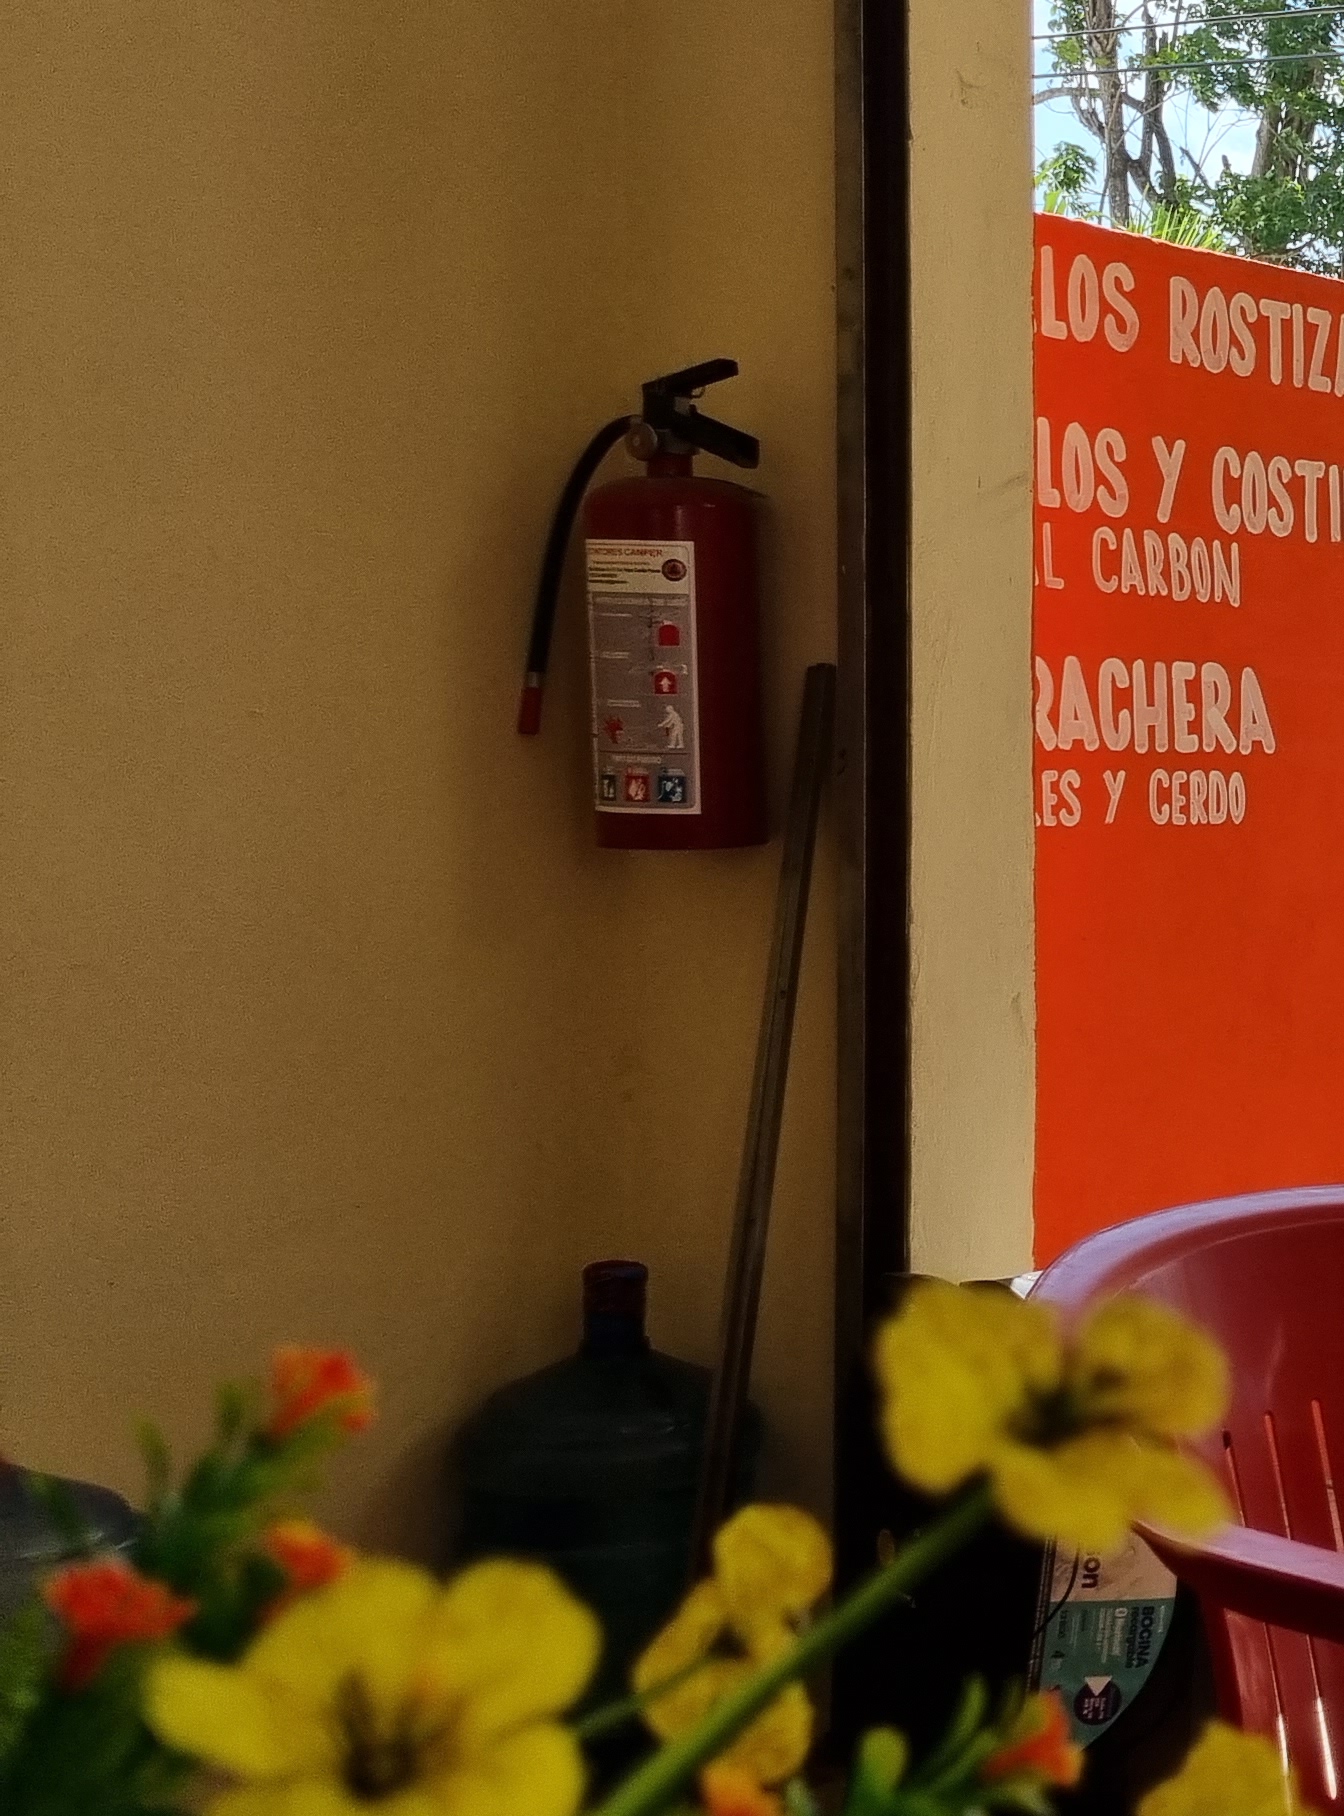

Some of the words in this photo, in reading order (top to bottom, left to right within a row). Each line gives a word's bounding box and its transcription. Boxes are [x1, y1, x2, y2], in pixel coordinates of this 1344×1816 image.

[1034, 245, 1140, 353] LOS
[1151, 435, 1186, 524] Y
[1034, 522, 1065, 589] L
[1092, 525, 1242, 608] CARBON
[1035, 769, 1082, 827] ES
[1103, 769, 1127, 824] Y
[1149, 768, 1246, 826] CERDO
[1136, 1606, 1155, 1669] BOCINA
